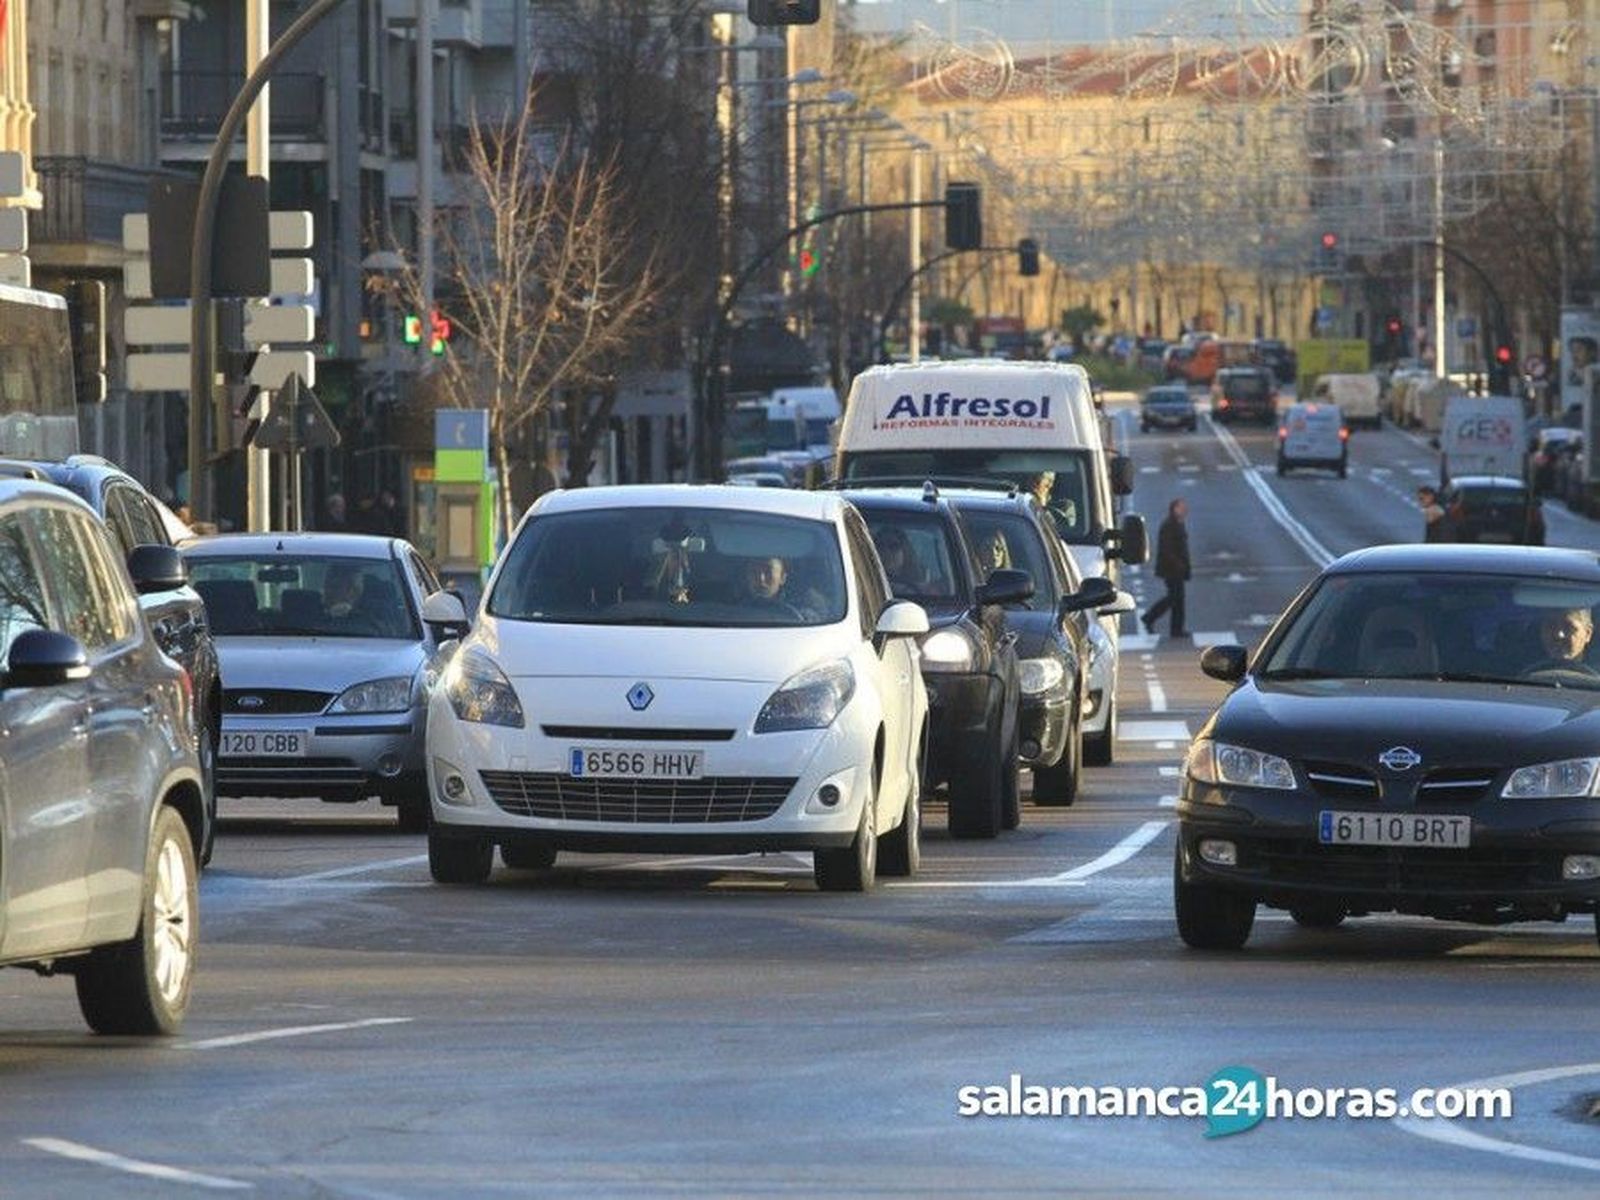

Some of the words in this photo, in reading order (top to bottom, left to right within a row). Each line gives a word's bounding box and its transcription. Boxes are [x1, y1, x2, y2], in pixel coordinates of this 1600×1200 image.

[886, 393, 1050, 419] Alfresol
[880, 418, 959, 430] REFORMAS
[964, 419, 1055, 430] INTEGRALES
[263, 735, 299, 752] CBB
[587, 752, 645, 774] 6566
[653, 753, 696, 775] HHV
[1337, 816, 1403, 841] 6110
[1413, 819, 1463, 843] BRT
